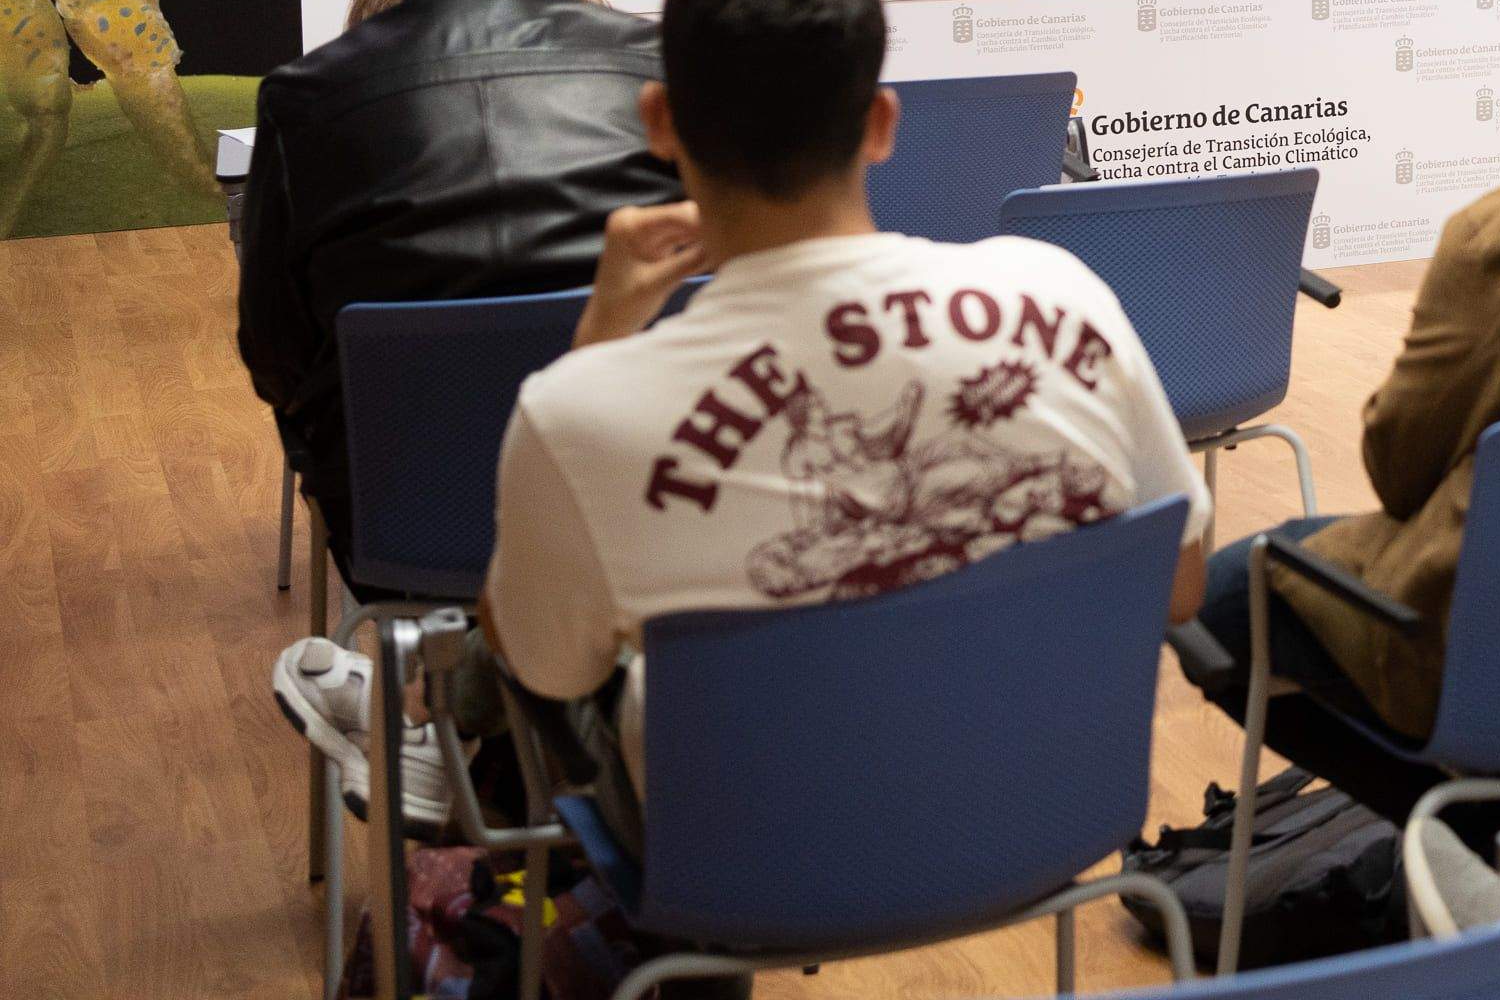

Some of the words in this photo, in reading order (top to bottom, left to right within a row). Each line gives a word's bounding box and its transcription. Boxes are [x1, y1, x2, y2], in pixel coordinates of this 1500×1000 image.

[976, 16, 1026, 28] Gobierno
[1027, 15, 1040, 25] de
[1041, 13, 1086, 25] Canarias
[1160, 5, 1206, 16] Gobierno
[1208, 5, 1219, 14] de
[1220, 2, 1263, 13] Canarias
[1091, 110, 1207, 136] Gobierno
[1213, 105, 1240, 126] de
[1245, 97, 1348, 125] Canarias
[1092, 141, 1178, 166] Consejería
[1183, 139, 1201, 157] de
[1206, 132, 1289, 154] Transición
[1294, 126, 1371, 148] Ecológica,
[1147, 161, 1199, 176] contra
[1204, 157, 1218, 172] el
[1222, 152, 1281, 170] Cambio
[1285, 145, 1358, 164] Climático
[645, 342, 812, 514] THE
[825, 288, 1113, 392] STONE
